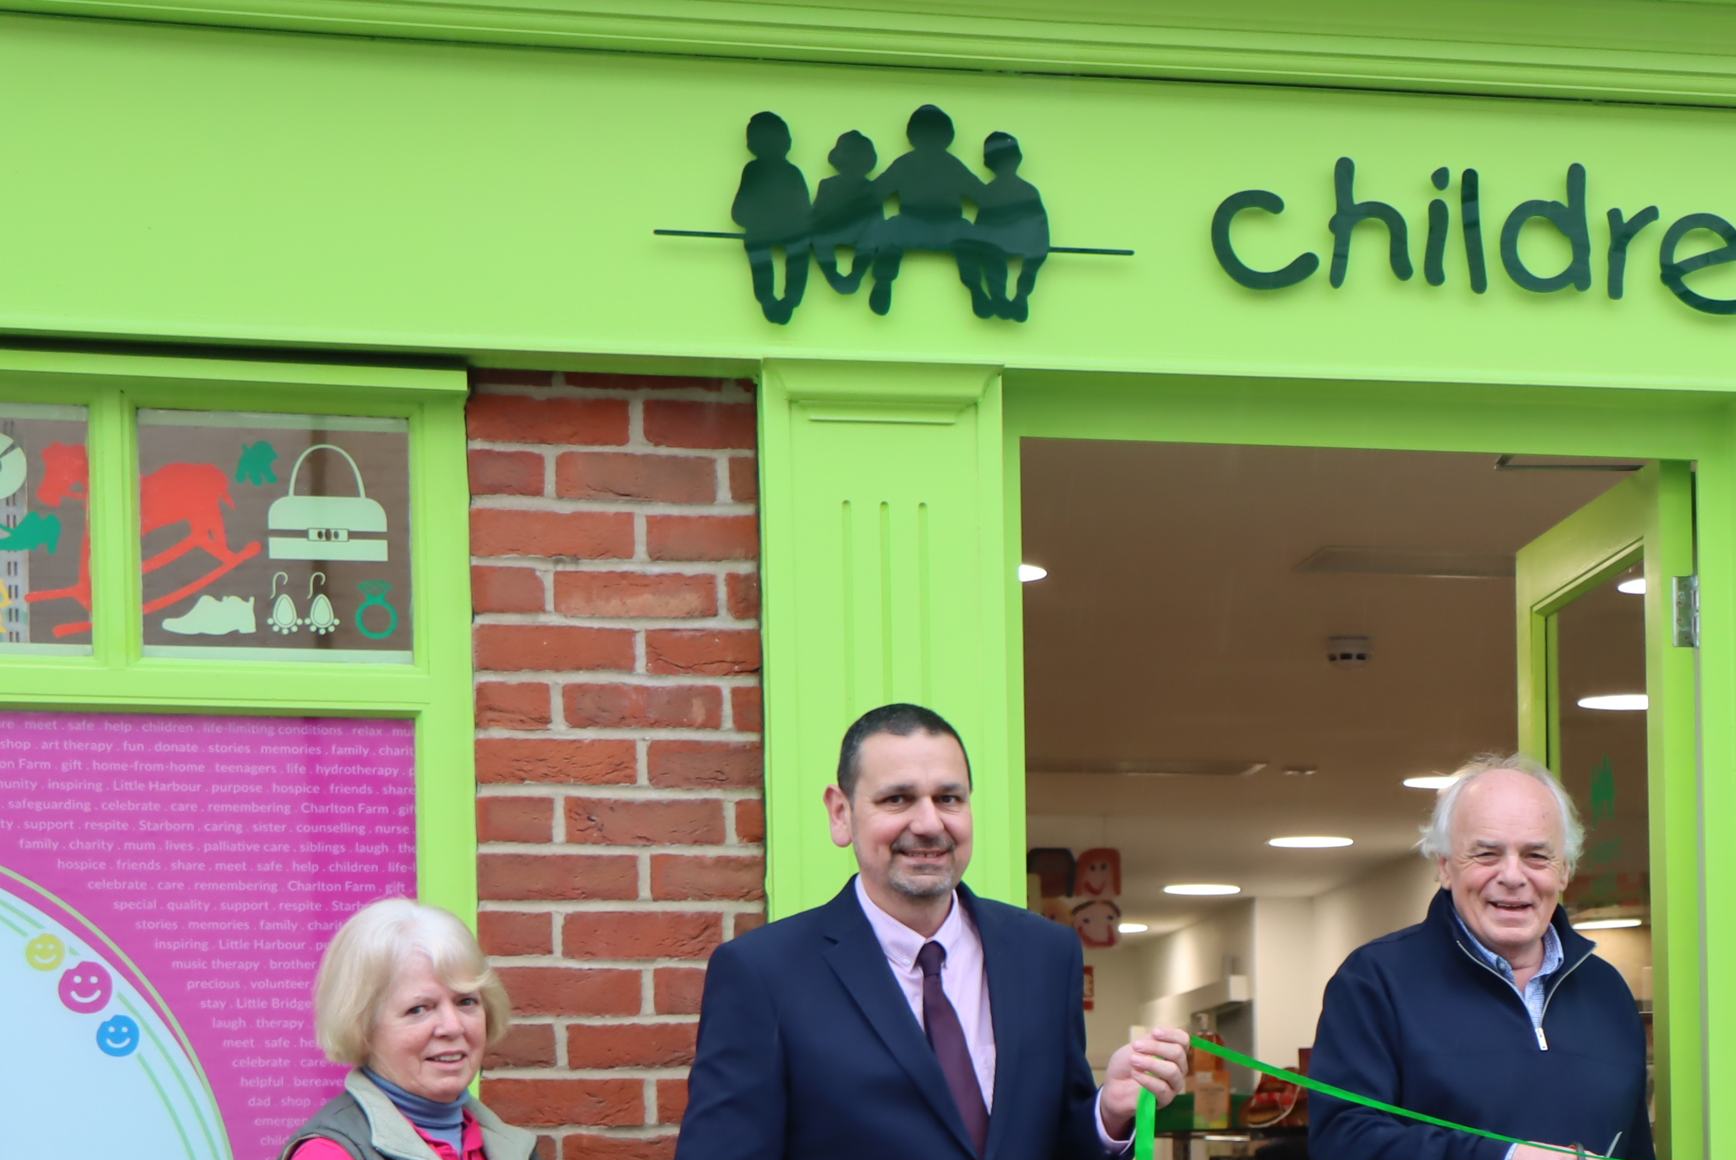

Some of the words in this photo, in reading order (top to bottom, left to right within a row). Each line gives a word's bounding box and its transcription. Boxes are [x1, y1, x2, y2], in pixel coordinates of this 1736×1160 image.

[24, 720, 57, 729] meet
[68, 720, 95, 731] safe
[104, 722, 132, 733] help
[141, 722, 193, 733] children
[203, 721, 275, 737] life-limiting
[278, 723, 343, 735] conditions
[352, 726, 383, 736] relax
[41, 741, 59, 750] art
[63, 740, 113, 753] therapy
[123, 741, 144, 752] fun
[154, 742, 198, 752] donate
[208, 743, 251, 753] stories
[260, 745, 322, 755] memories
[331, 745, 370, 757] family
[378, 746, 415, 756] charit
[19, 759, 51, 769] Farm
[61, 760, 82, 773] gift
[92, 760, 205, 773] home-from-home
[215, 763, 277, 774] teenagers
[286, 763, 306, 774] life
[316, 764, 400, 777] hydrotherapy
[48, 779, 103, 793] inspiring
[113, 781, 145, 791] Little
[149, 781, 201, 792] Harbour
[211, 783, 263, 794] purpose
[272, 783, 320, 795] hospice
[330, 783, 373, 794] friends
[8, 799, 92, 812] safeguarding
[101, 800, 160, 812] celebrate
[170, 803, 198, 812] care
[208, 802, 292, 814] remembering
[300, 802, 355, 813] Charlton
[358, 803, 389, 814] Farm
[24, 819, 74, 831] support
[84, 820, 129, 832] respite
[139, 820, 194, 831] Starborn
[204, 822, 242, 834] caring
[252, 823, 287, 832] sister
[296, 823, 366, 835] counselling
[375, 825, 409, 834] nurse
[19, 839, 59, 851] family
[69, 839, 114, 851] charity
[123, 841, 155, 850] mum
[165, 840, 194, 851] lives
[204, 842, 260, 853] palliative
[263, 844, 290, 853] care
[299, 843, 346, 854] siblings
[355, 842, 388, 855] laugh
[57, 859, 107, 870] hospice
[116, 859, 161, 871] friends
[171, 860, 206, 871] share
[215, 861, 247, 872] meet
[256, 861, 283, 872] safe
[292, 861, 319, 874] help
[329, 862, 379, 873] children
[87, 879, 147, 890] celebrate
[157, 881, 185, 890] care
[194, 880, 278, 892] remembering
[288, 881, 342, 892] Charlton
[345, 881, 376, 892] Farm
[113, 899, 157, 911] special
[167, 900, 210, 912] quality
[220, 900, 269, 912] support
[279, 900, 322, 912] respite
[135, 920, 178, 930] stories
[188, 920, 250, 930] memories
[260, 920, 298, 932] family
[155, 939, 209, 951] inspiring
[219, 939, 250, 950] Little
[254, 939, 306, 950] Harbour
[172, 959, 207, 969] music
[212, 958, 260, 971] therapy
[270, 958, 316, 970] brother
[187, 979, 241, 991] precious
[250, 980, 310, 989] volunteer
[200, 999, 226, 1011] stay
[237, 998, 268, 1009] Little
[212, 1018, 246, 1030] laugh
[256, 1018, 304, 1031] therapy
[223, 1038, 255, 1048] meet
[264, 1038, 290, 1048] safe
[232, 1057, 291, 1068] celebrate
[300, 1059, 326, 1068] care
[240, 1076, 284, 1089] helpful
[293, 1077, 343, 1087] bereave
[248, 1096, 271, 1107] dad
[281, 1097, 311, 1108] shop
